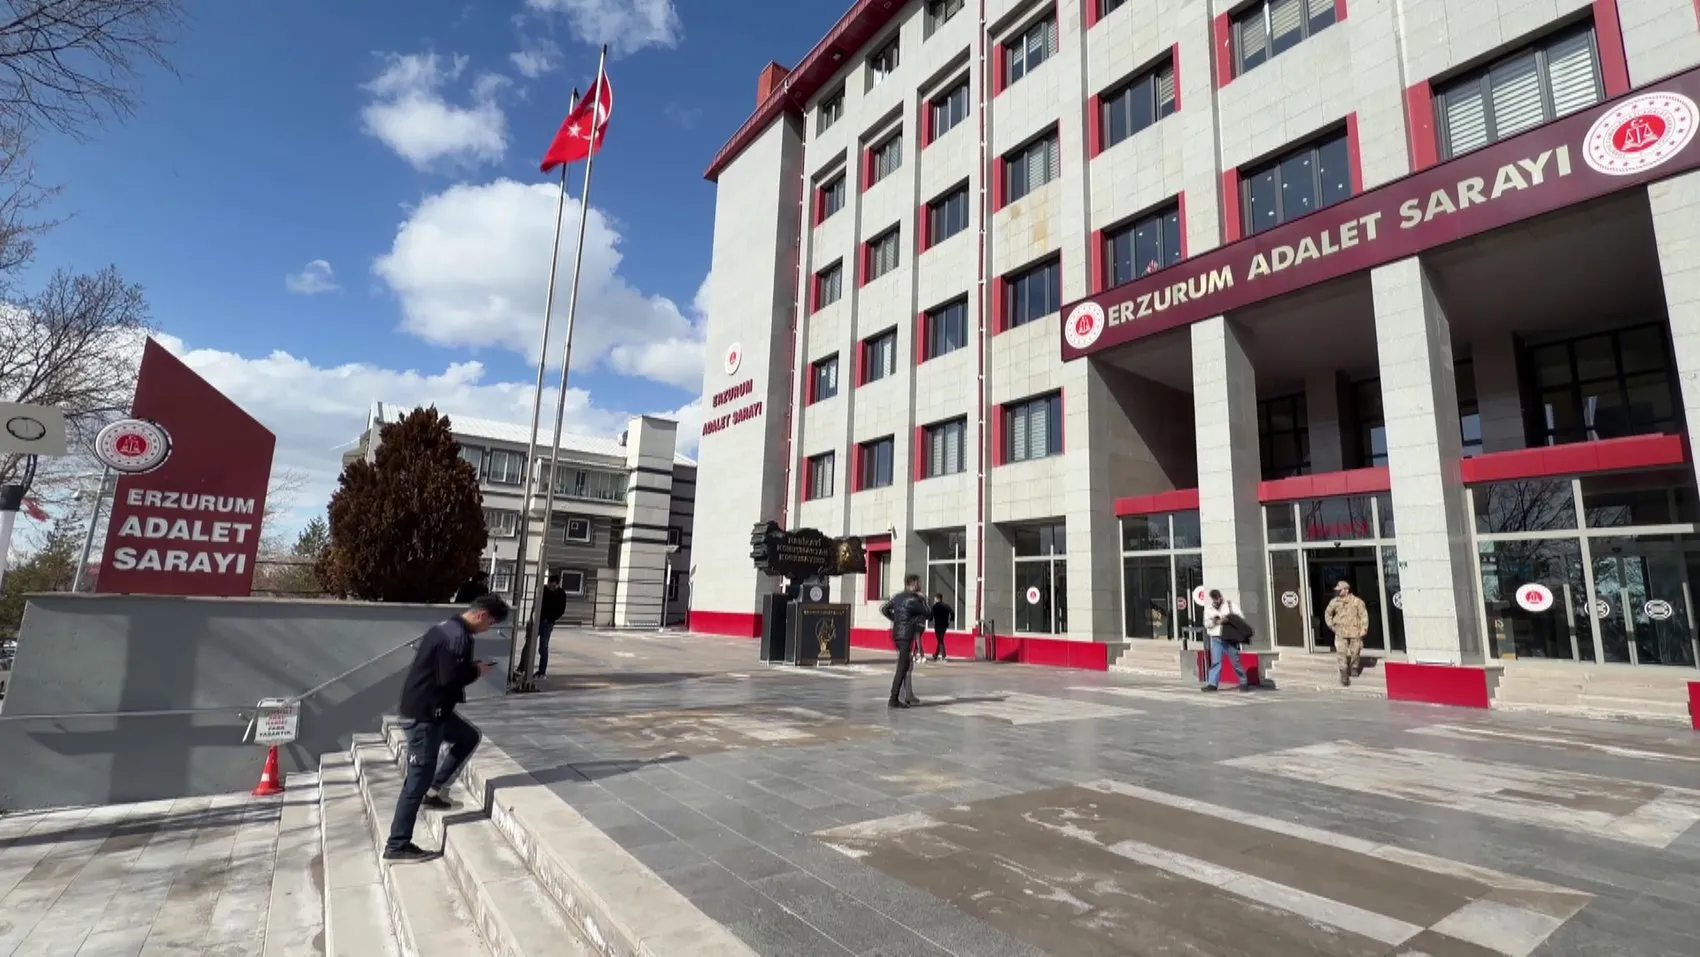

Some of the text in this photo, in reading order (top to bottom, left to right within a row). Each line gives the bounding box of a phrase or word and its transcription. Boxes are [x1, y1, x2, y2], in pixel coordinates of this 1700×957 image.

[1108, 144, 1572, 327] ERZURUM ADALET SARAYI
[712, 378, 753, 408] ERZURUM
[702, 401, 762, 436] ADALET SARAYI
[127, 488, 255, 514] ERZURUM
[118, 514, 252, 544] ADALET
[113, 546, 247, 575] SARAYI
